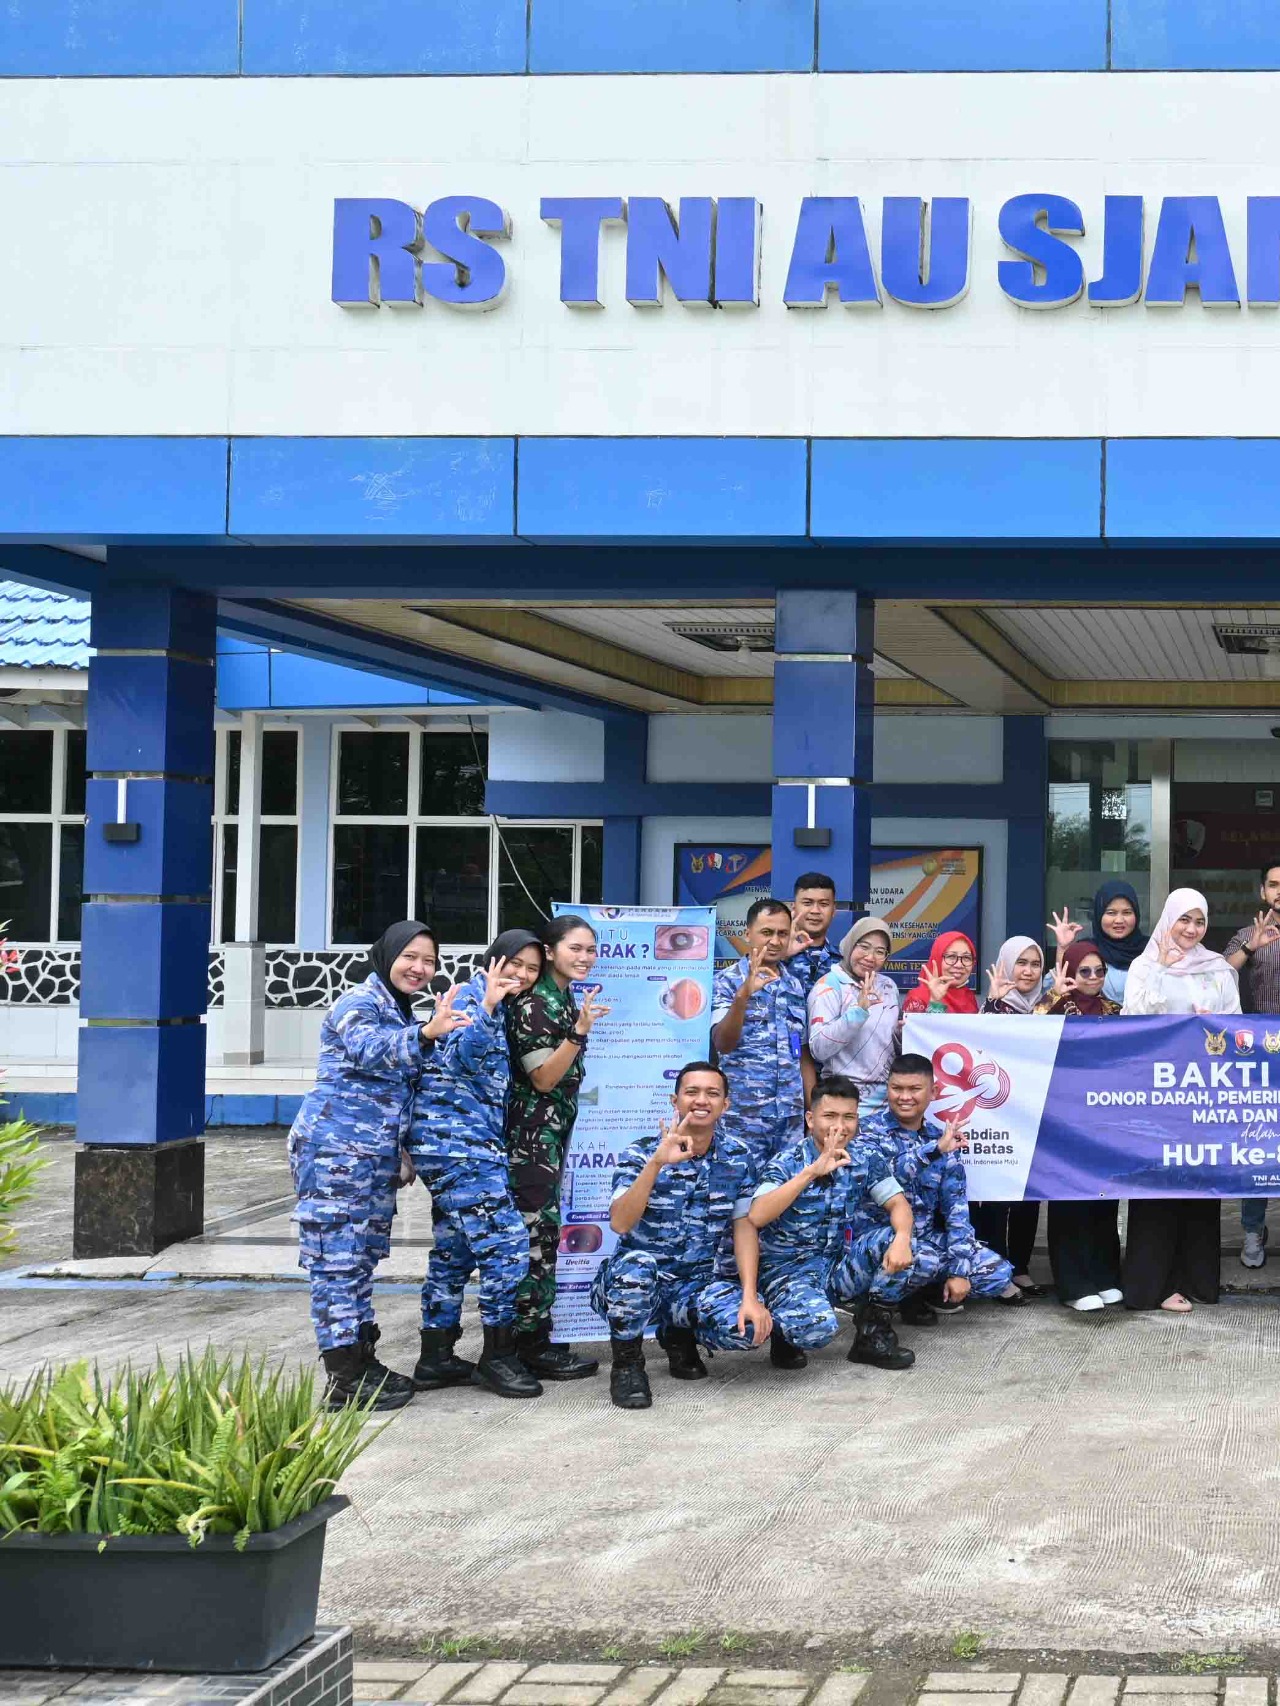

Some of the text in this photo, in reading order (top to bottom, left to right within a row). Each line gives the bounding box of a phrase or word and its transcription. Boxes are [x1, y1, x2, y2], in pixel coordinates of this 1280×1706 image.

[332, 196, 514, 312] RS
[540, 196, 763, 310] TNI
[784, 197, 974, 311] AU
[1153, 1061, 1269, 1088] BAKTI
[1086, 1091, 1147, 1106] DONOR
[1151, 1091, 1213, 1107] DARAH,
[1192, 1109, 1238, 1124] MATA
[1243, 1109, 1278, 1123] DAN
[973, 1143, 1014, 1154] Batas
[1162, 1143, 1224, 1167] HUT
[566, 1153, 617, 1168] TARA
